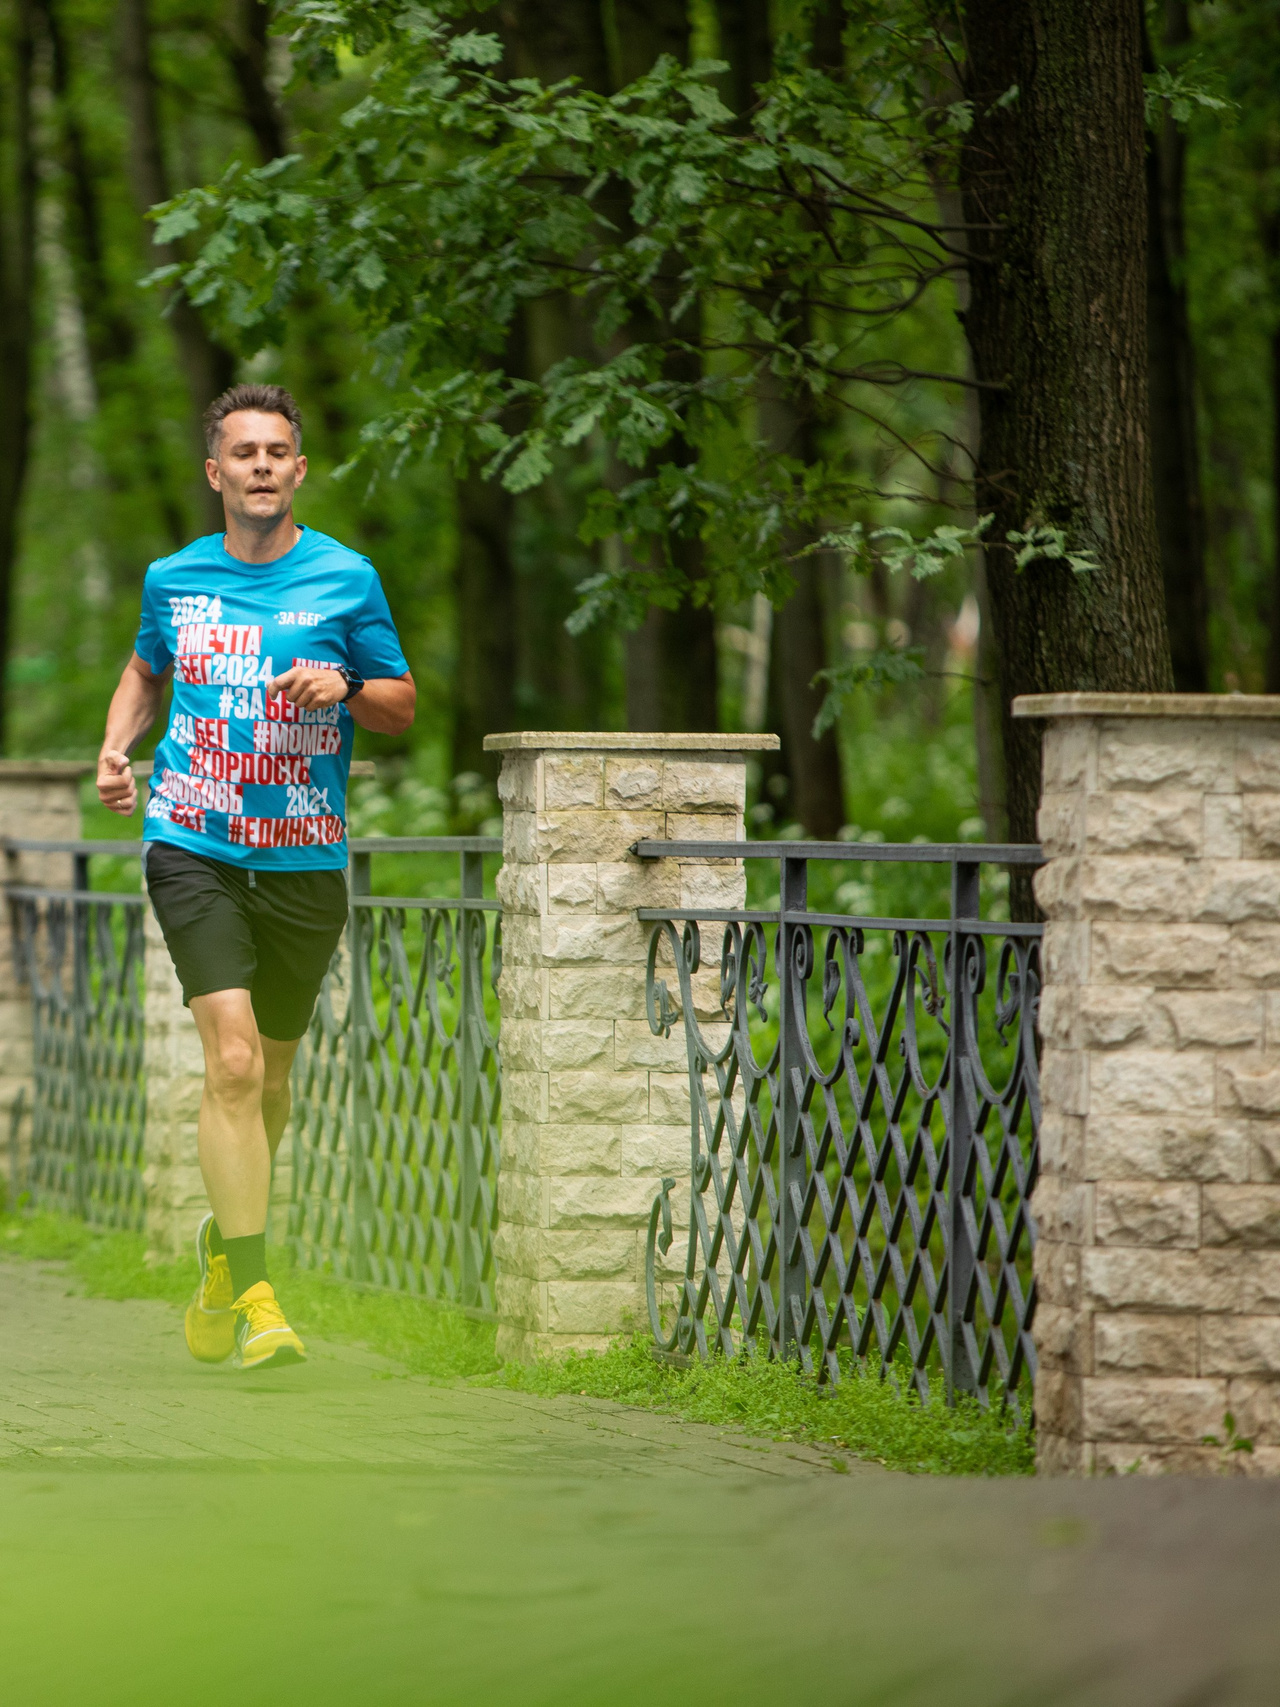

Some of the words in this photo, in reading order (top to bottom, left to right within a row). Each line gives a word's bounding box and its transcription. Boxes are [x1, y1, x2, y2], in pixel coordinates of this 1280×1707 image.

[168, 595, 222, 627] 2024
[177, 625, 262, 656] #МЕЧТА
[188, 746, 312, 785] #ГОРДОСТЬ
[228, 815, 344, 849] #ЕДИНСТВО
